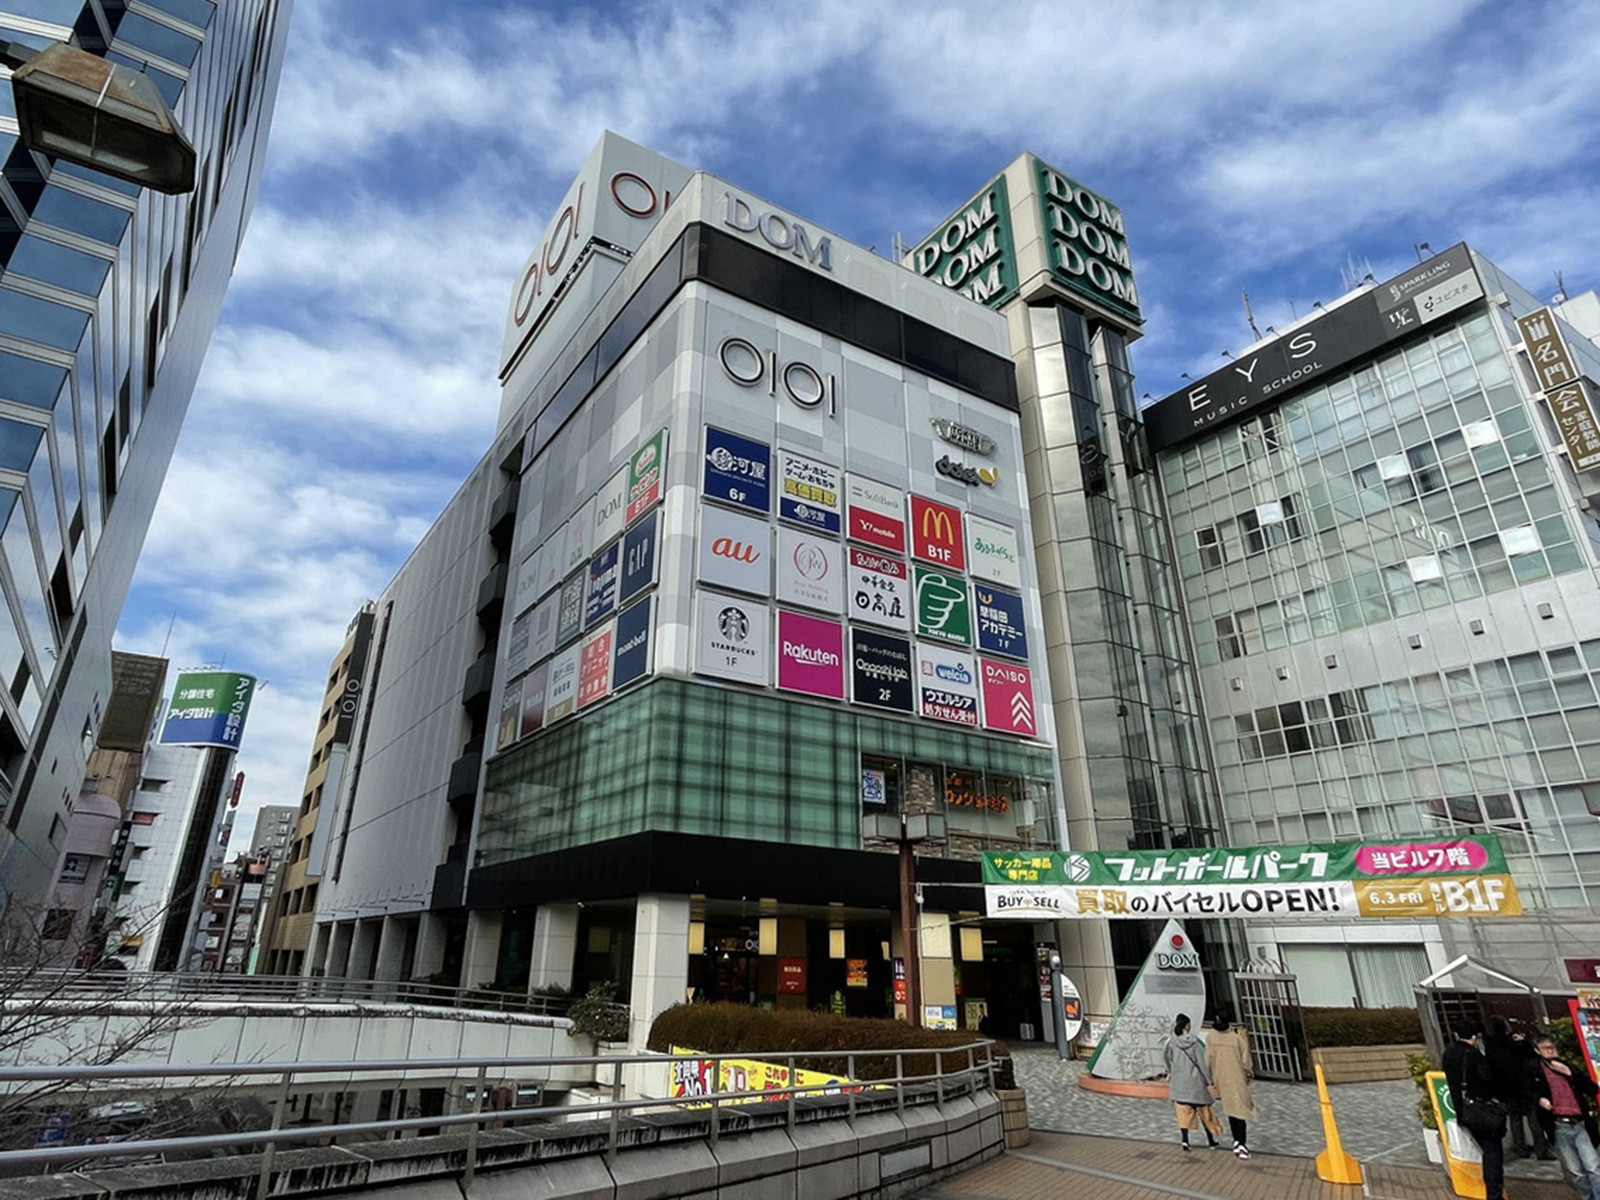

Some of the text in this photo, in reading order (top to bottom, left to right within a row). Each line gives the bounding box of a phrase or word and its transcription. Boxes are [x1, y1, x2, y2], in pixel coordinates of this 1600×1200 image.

[1042, 168, 1125, 238] DOM
[724, 191, 833, 271] DOM
[916, 190, 996, 275] DOM
[1048, 203, 1131, 273] DOM
[1053, 238, 1138, 309] DOM
[1193, 361, 1323, 427] MUSIC SCHOOL
[729, 488, 746, 502] 6F
[711, 537, 760, 563] au
[927, 544, 952, 562] B1F
[711, 641, 756, 656] STARBUCKS
[783, 641, 838, 667] Rakuten
[726, 656, 738, 667] 1F
[986, 665, 1027, 684] DAISO
[879, 688, 892, 701] 2F
[925, 689, 973, 708] ウエルシア
[1104, 851, 1329, 882] フットボールパーク
[997, 895, 1060, 909] BUY SELL
[1369, 891, 1424, 905] 6.3 FRI
[1442, 878, 1506, 913] B1F
[1156, 952, 1199, 969] DOM
